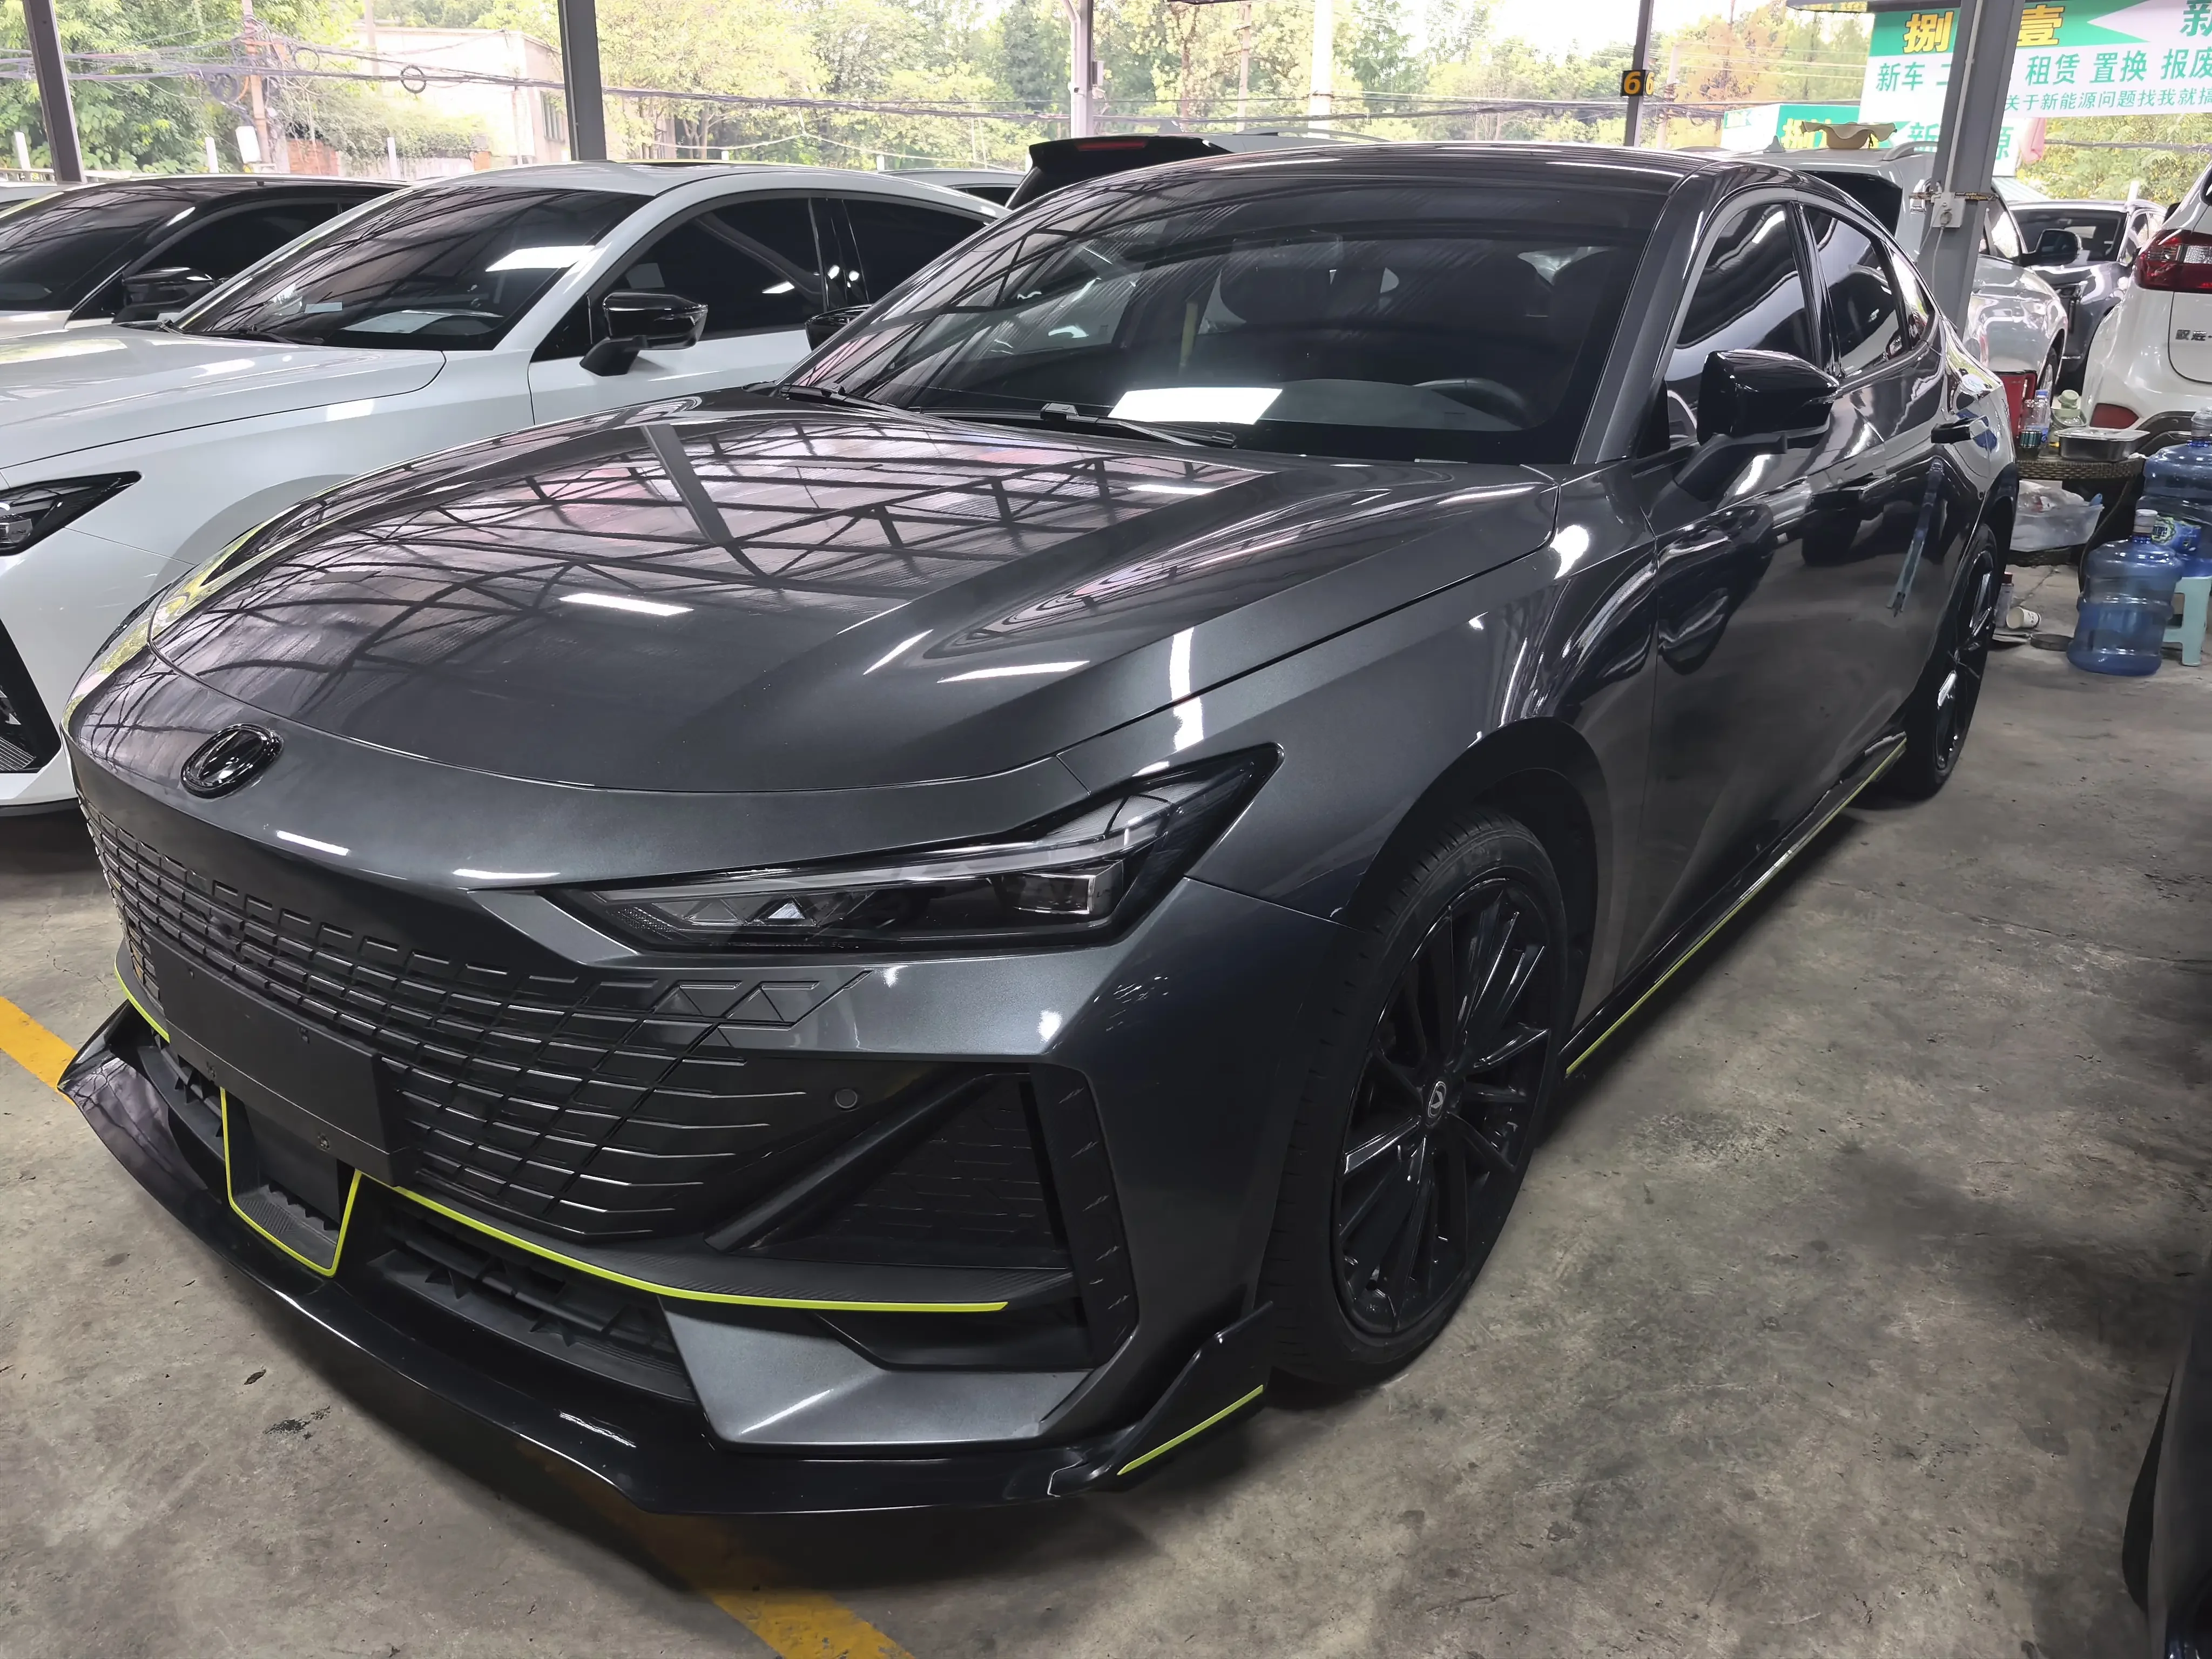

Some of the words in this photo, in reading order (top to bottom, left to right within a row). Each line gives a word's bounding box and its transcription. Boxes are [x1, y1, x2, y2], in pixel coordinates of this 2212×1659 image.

[1876, 62, 1925, 92] 新车
[2025, 53, 2080, 86] 租赁
[2089, 50, 2147, 83] 置换
[2160, 46, 2212, 80] 报废
[1624, 71, 1641, 95] 6
[1645, 71, 1655, 95] 6
